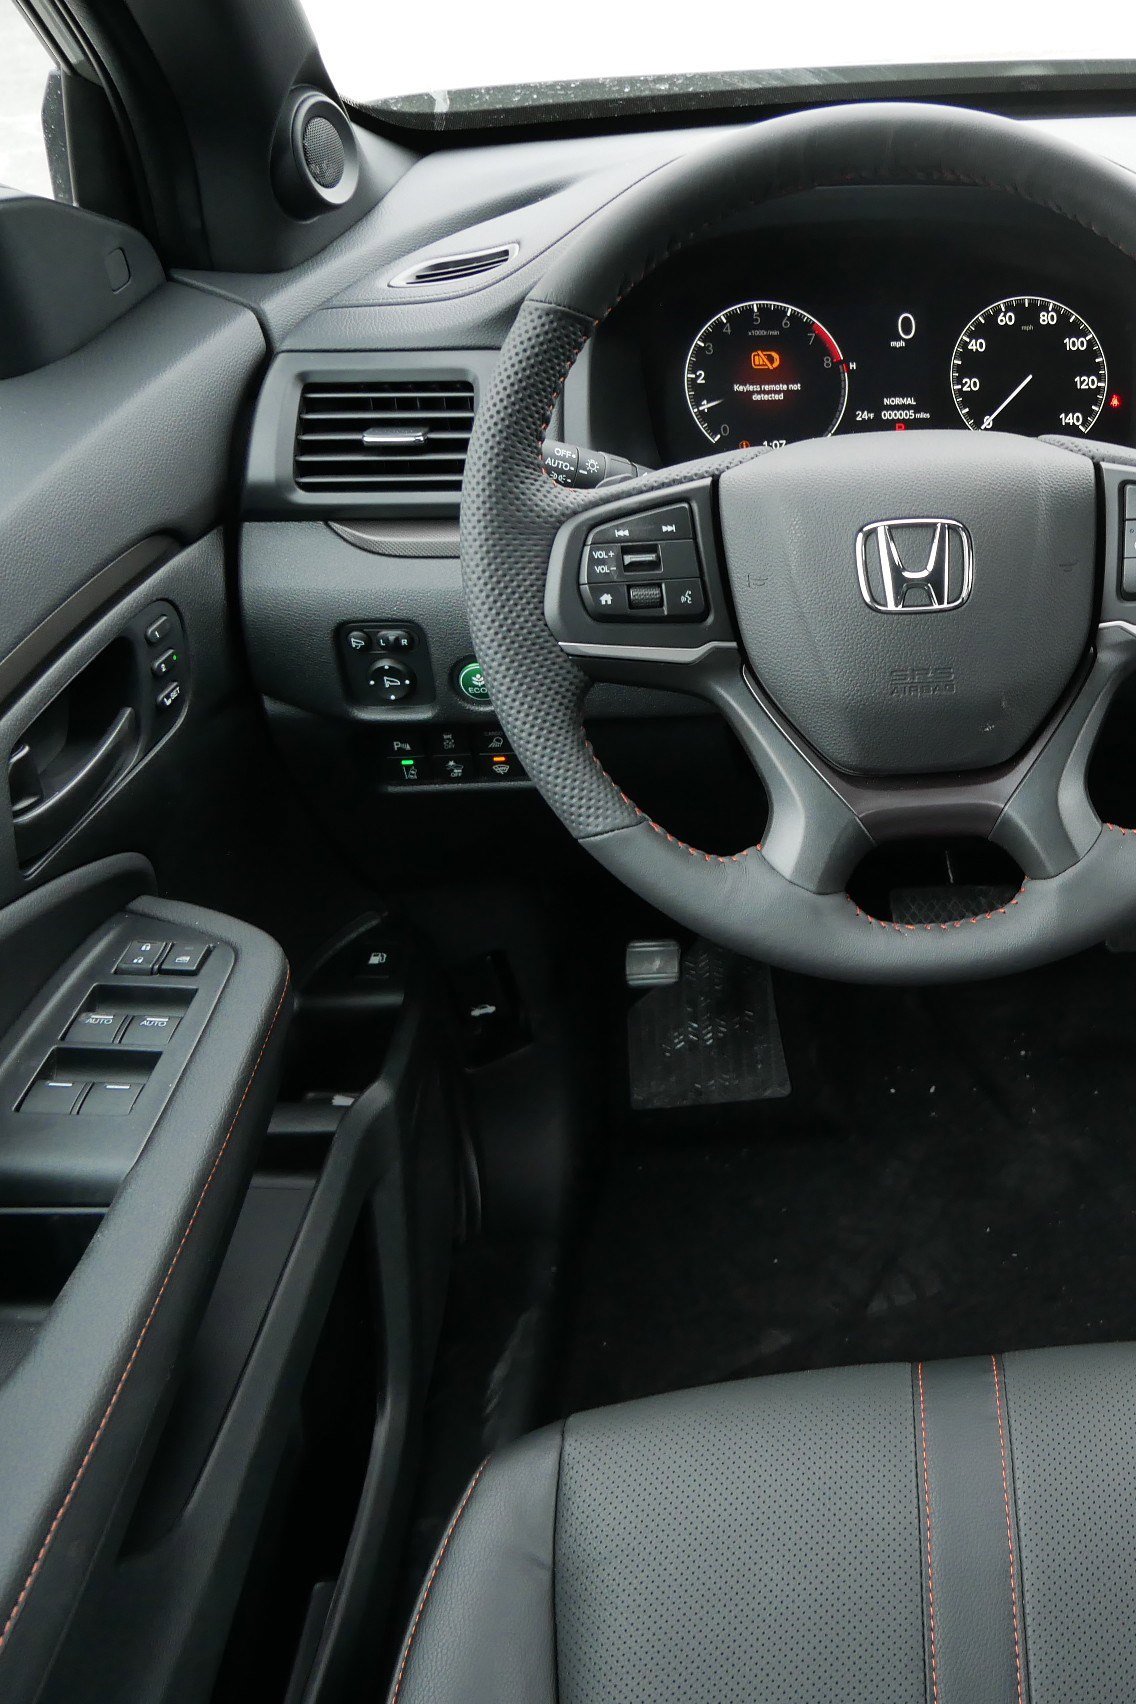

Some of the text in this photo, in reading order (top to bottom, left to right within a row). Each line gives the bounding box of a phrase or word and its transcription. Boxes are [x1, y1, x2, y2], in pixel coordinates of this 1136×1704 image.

[753, 313, 760, 324] 5
[782, 317, 790, 328] 6
[997, 312, 1015, 325] 60
[1039, 312, 1057, 325] 80
[723, 324, 731, 335] 4
[898, 313, 916, 339] 0
[807, 333, 815, 345] 7
[1063, 338, 1087, 350] 100
[705, 343, 713, 354] 3
[968, 339, 985, 352] 40
[824, 356, 832, 368] 8
[696, 371, 705, 383] 2
[1074, 376, 1097, 389] 120
[734, 384, 760, 392] Keyless
[962, 378, 980, 391] 20
[882, 410, 915, 419] 000005
[1059, 413, 1082, 426] 140
[984, 416, 993, 428] 0
[721, 424, 730, 436] 0
[554, 448, 571, 458] OFF
[545, 458, 569, 471] AUTO
[170, 686, 180, 700] SET
